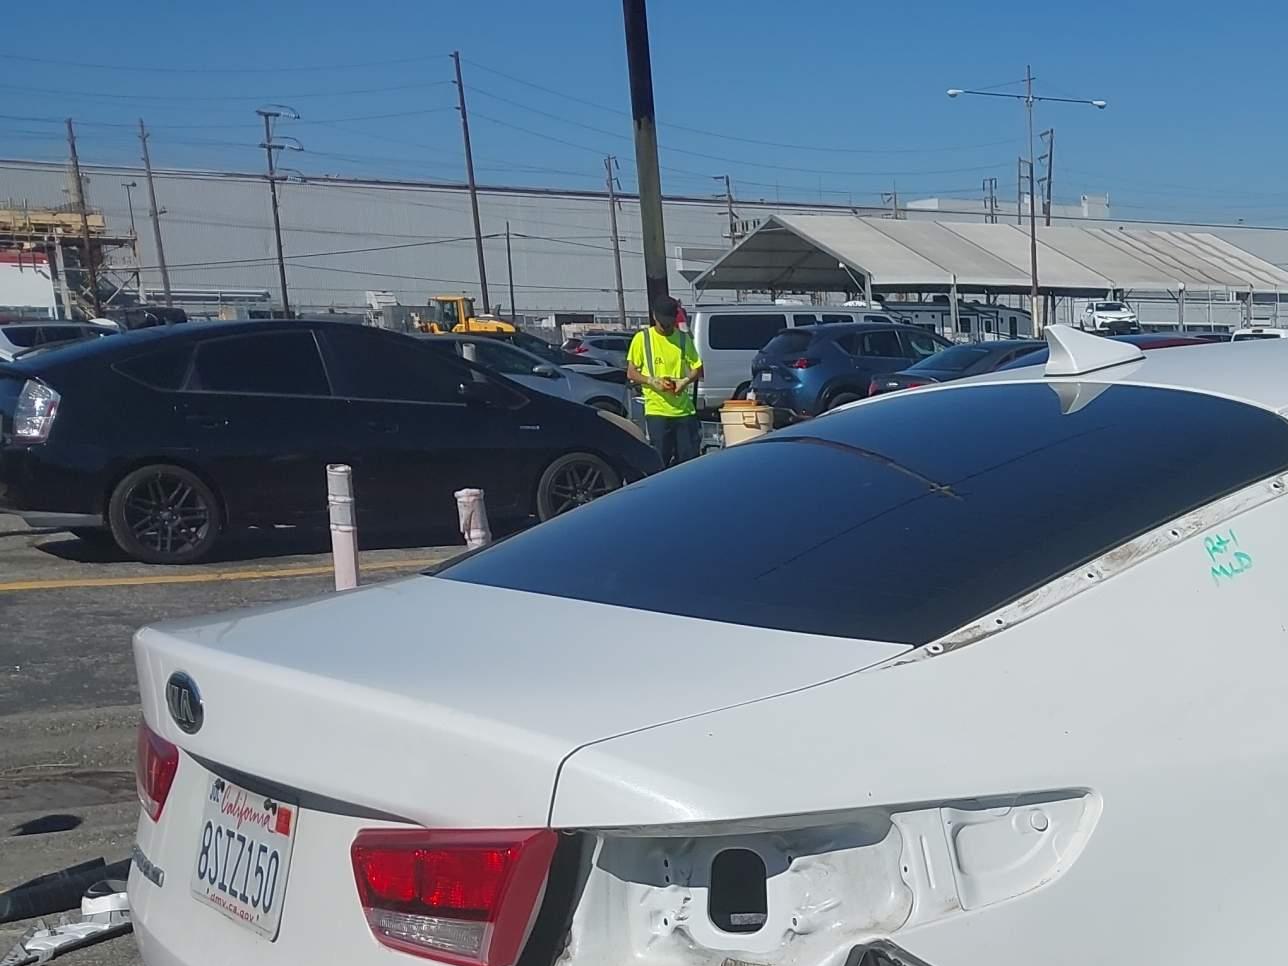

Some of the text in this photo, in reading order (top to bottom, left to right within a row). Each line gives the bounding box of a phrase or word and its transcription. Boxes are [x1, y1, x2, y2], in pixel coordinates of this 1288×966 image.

[222, 784, 275, 833] California
[197, 820, 279, 914] 8SIZ150
[210, 893, 255, 922] dmv.ca.gov
